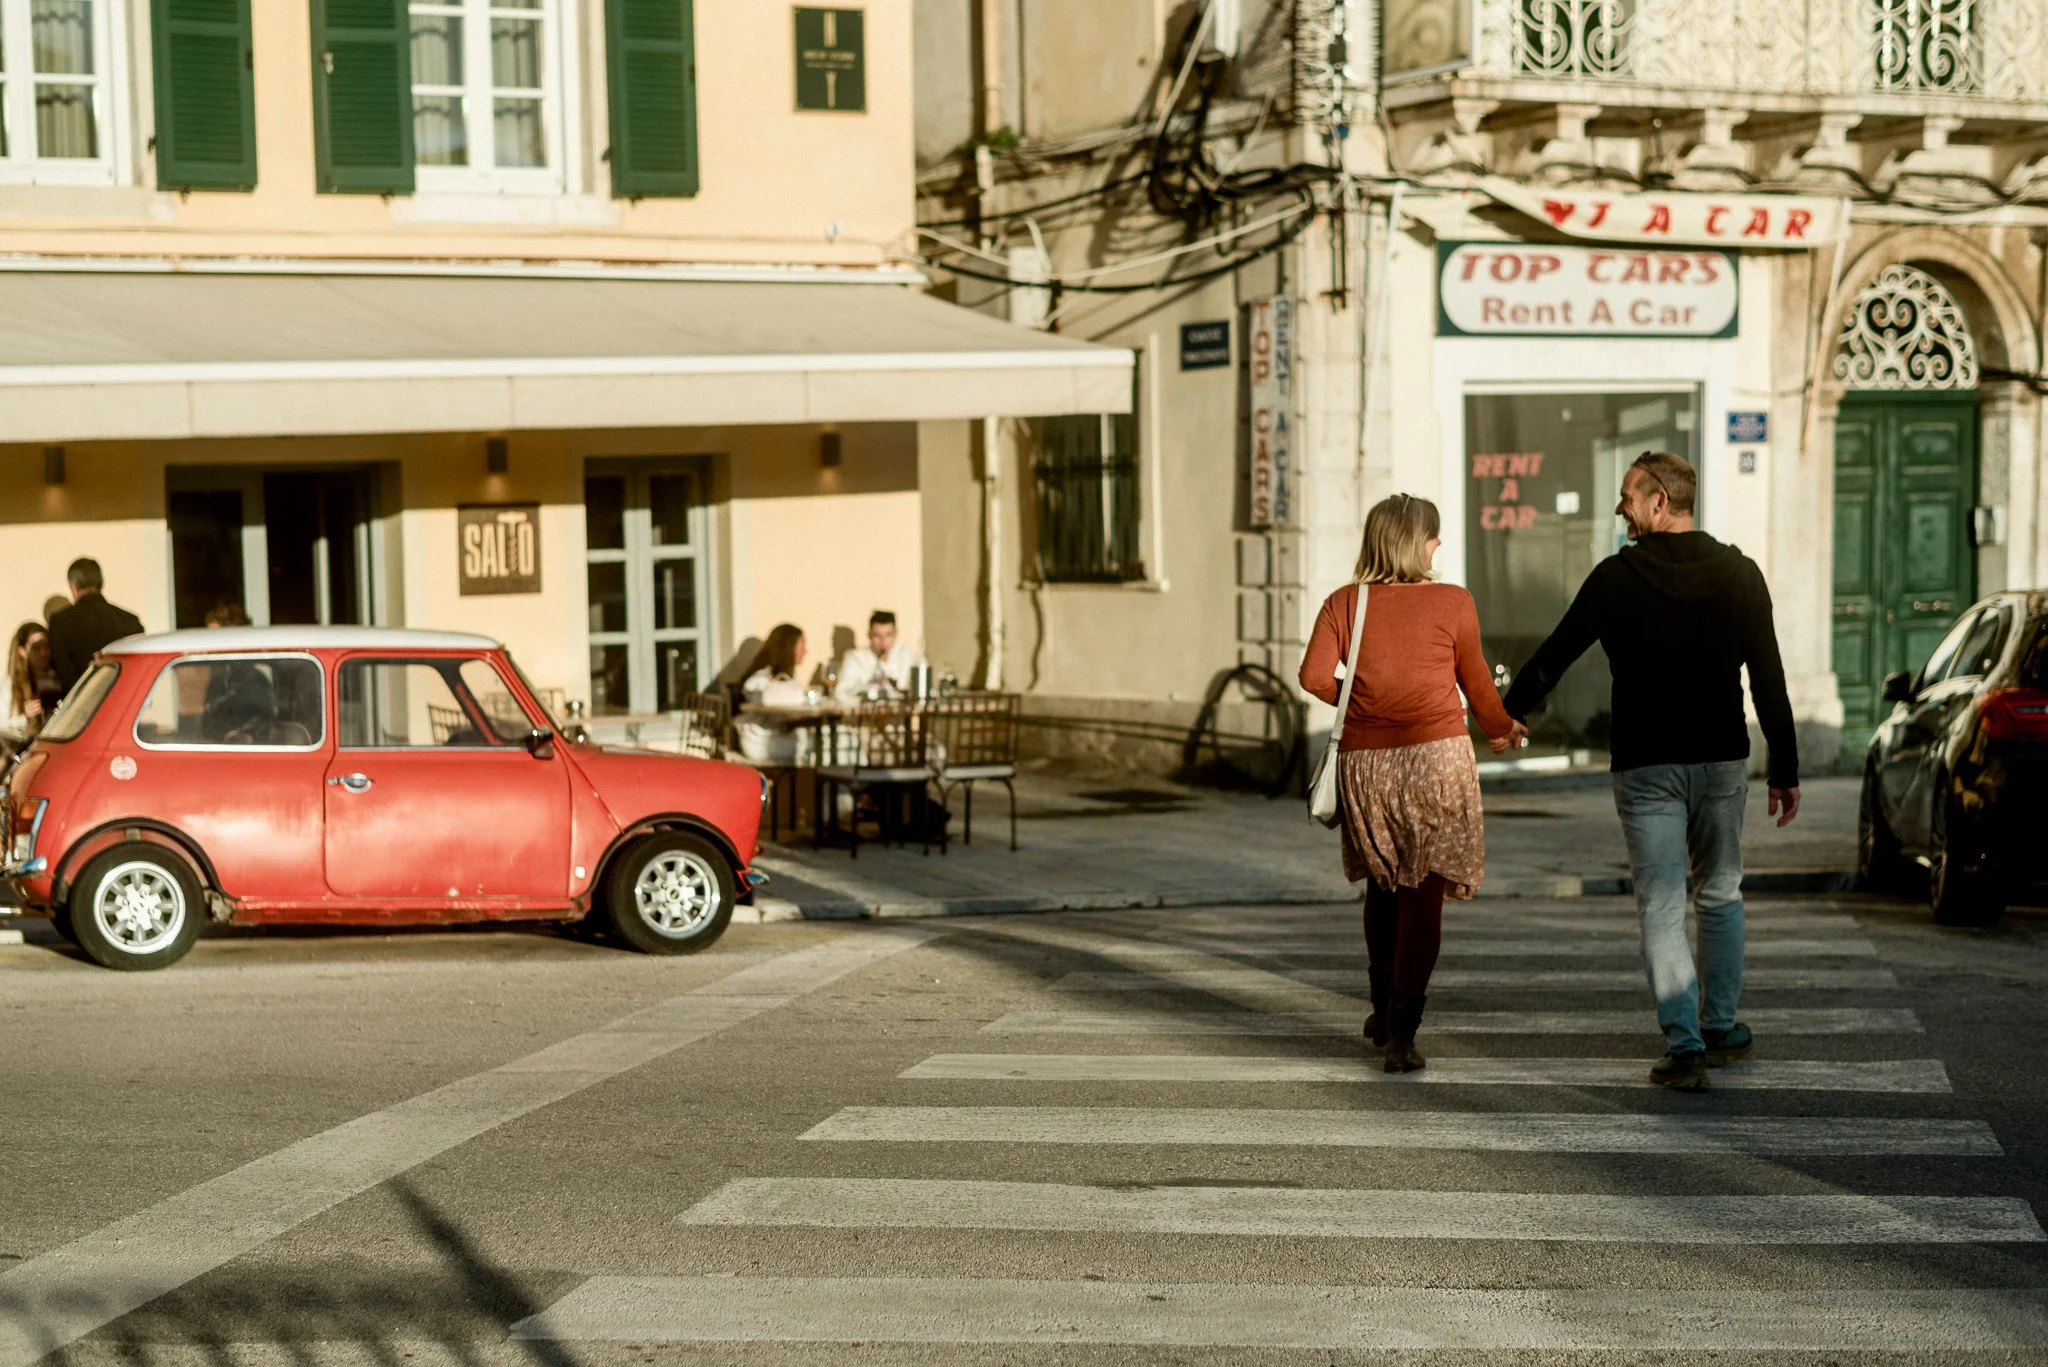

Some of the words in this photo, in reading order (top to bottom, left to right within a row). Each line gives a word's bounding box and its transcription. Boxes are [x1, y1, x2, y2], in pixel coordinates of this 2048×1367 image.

[1642, 204, 1671, 233] A
[1704, 205, 1813, 238] CAR
[1460, 252, 1562, 283] TOP
[1586, 251, 1722, 284] CARS
[1481, 296, 1573, 325] Rent
[1588, 297, 1615, 325] A
[1629, 297, 1697, 326] Car
[1255, 298, 1270, 387] TOP
[1255, 408, 1271, 522] CARS
[1472, 452, 1544, 478] RENT
[1499, 478, 1520, 502] A
[1480, 505, 1537, 529] CAR
[463, 511, 534, 578] SALTO
